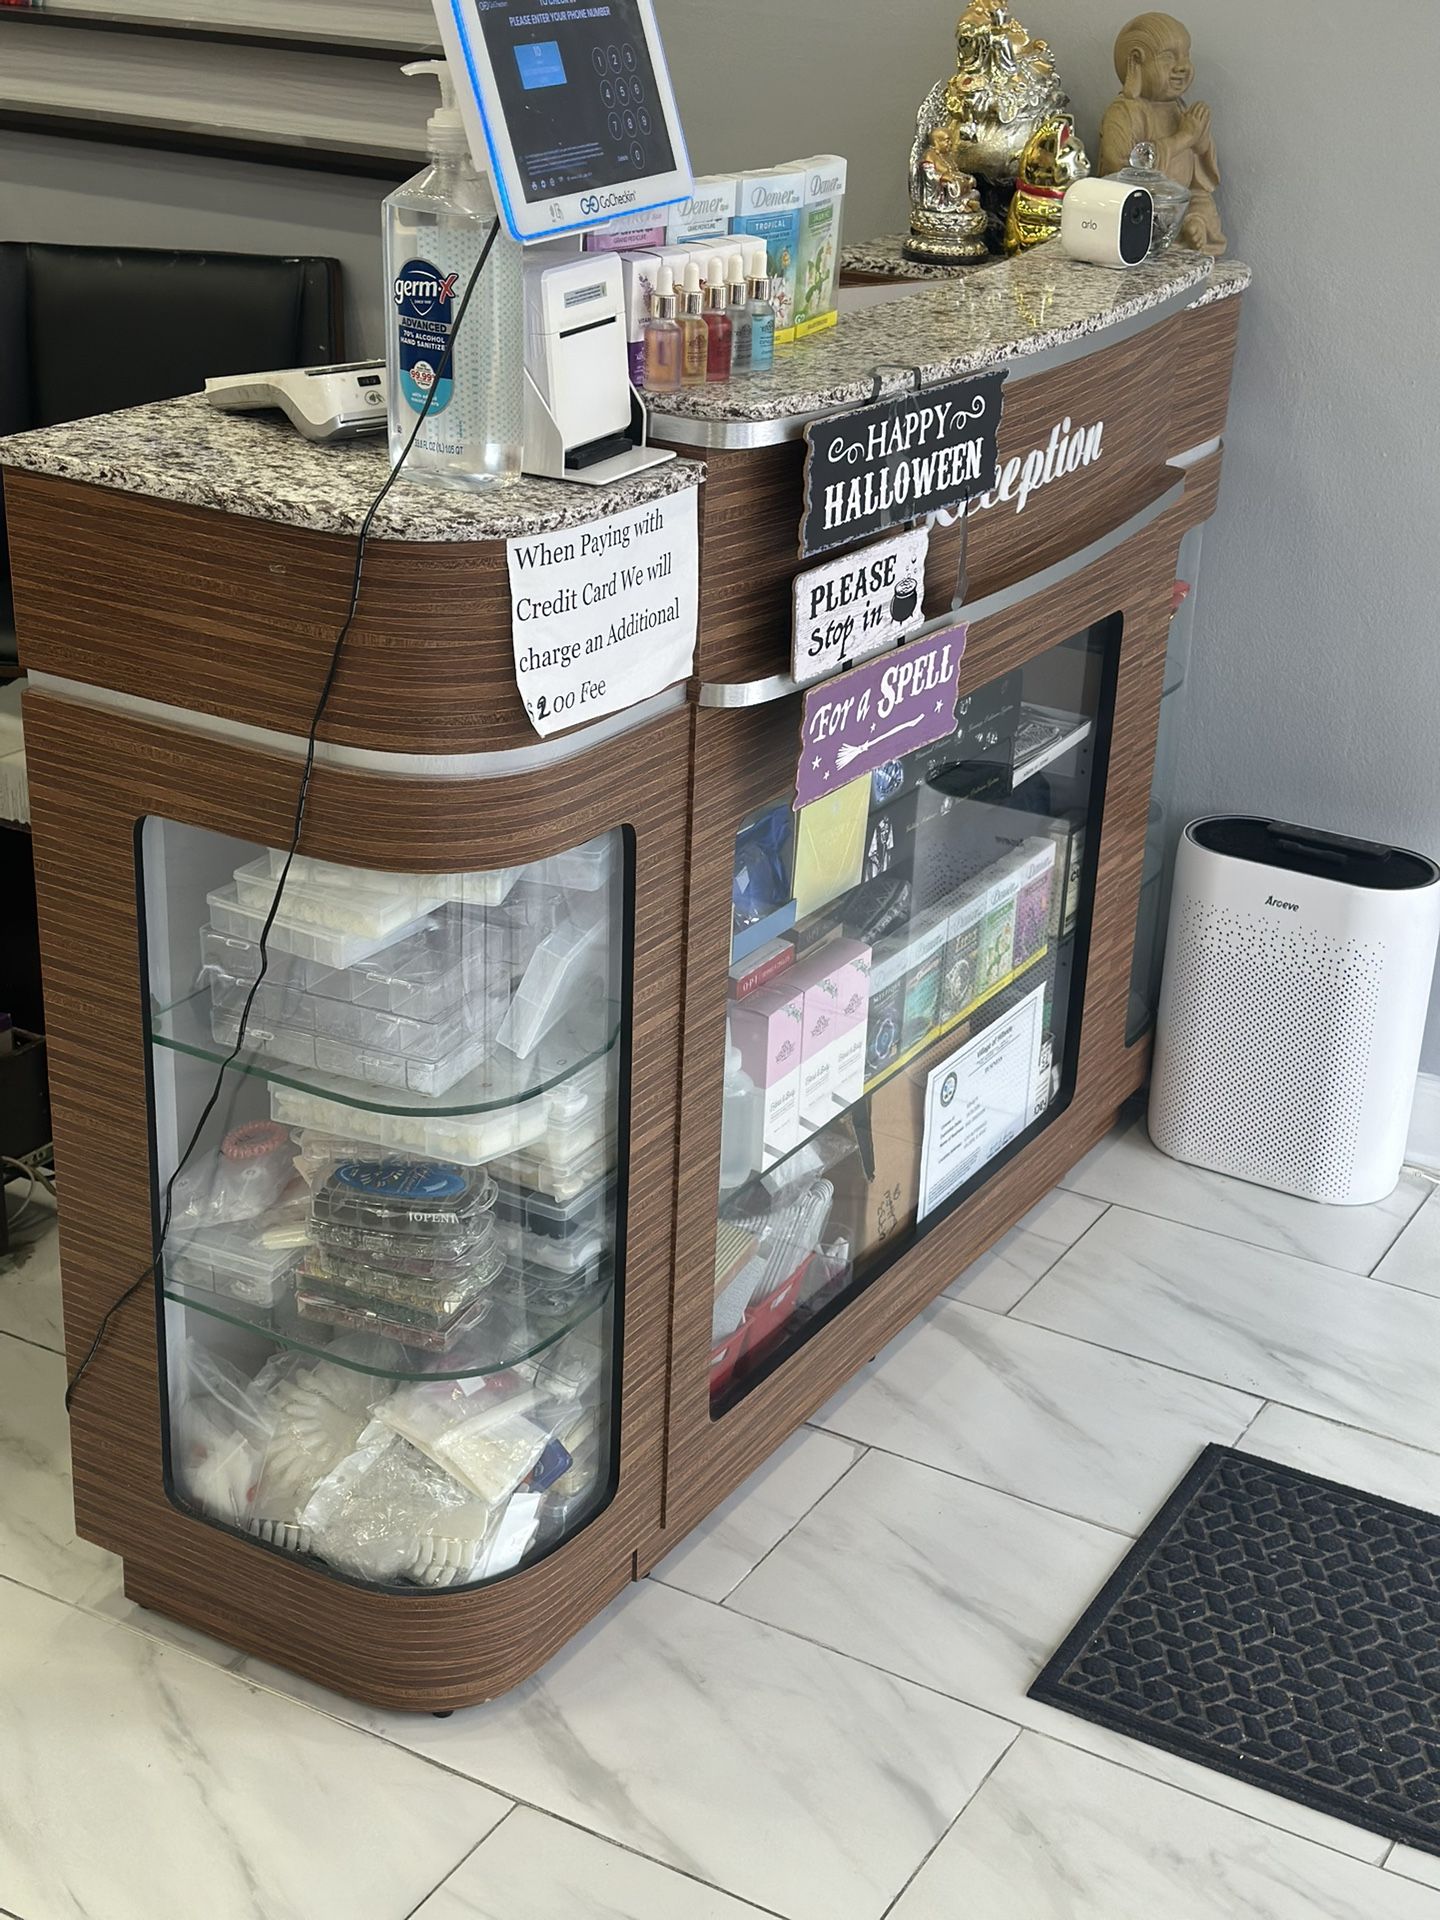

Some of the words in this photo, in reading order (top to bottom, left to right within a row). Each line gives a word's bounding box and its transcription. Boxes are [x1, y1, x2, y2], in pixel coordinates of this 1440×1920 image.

[508, 15, 532, 27] PLEASE
[531, 12, 551, 25] ENTER
[550, 11, 568, 22] YOUR
[567, 8, 588, 20] PHONE
[587, 6, 611, 17] NUMBER
[612, 54, 618, 65] 2
[626, 52, 632, 63] 3
[605, 88, 611, 99] 4
[619, 86, 626, 97] 5
[633, 84, 640, 94] 6
[627, 118, 633, 129] 8
[641, 115, 647, 126] 9
[810, 175, 838, 196] Demer
[677, 196, 722, 217] Demer
[751, 186, 794, 209] Demer
[755, 218, 786, 231] TROPICAL
[1081, 219, 1098, 231] arlo
[401, 316, 448, 333] ADVANCED
[400, 336, 416, 346] HAND
[416, 340, 448, 352] SANITIZE
[403, 329, 415, 339] 70%
[415, 332, 446, 344] ALCOHOL
[864, 401, 953, 462] HAPPY
[822, 436, 985, 530] HALLOWEEN
[513, 541, 575, 571] When
[580, 524, 631, 557] Paying
[633, 508, 664, 537] with
[516, 588, 578, 622] Credit
[582, 572, 617, 607] Card
[620, 565, 644, 591] We
[646, 551, 672, 582] will
[808, 554, 898, 621] PLEASE
[862, 599, 884, 632] in
[519, 642, 581, 673] charge
[584, 634, 604, 655] an
[606, 597, 680, 646] Additional
[580, 678, 607, 705] Fee
[809, 695, 856, 744] For
[856, 687, 873, 724] a
[876, 643, 955, 720] SPELL
[742, 975, 760, 992] OPI
[413, 1211, 451, 1224] OPEN
